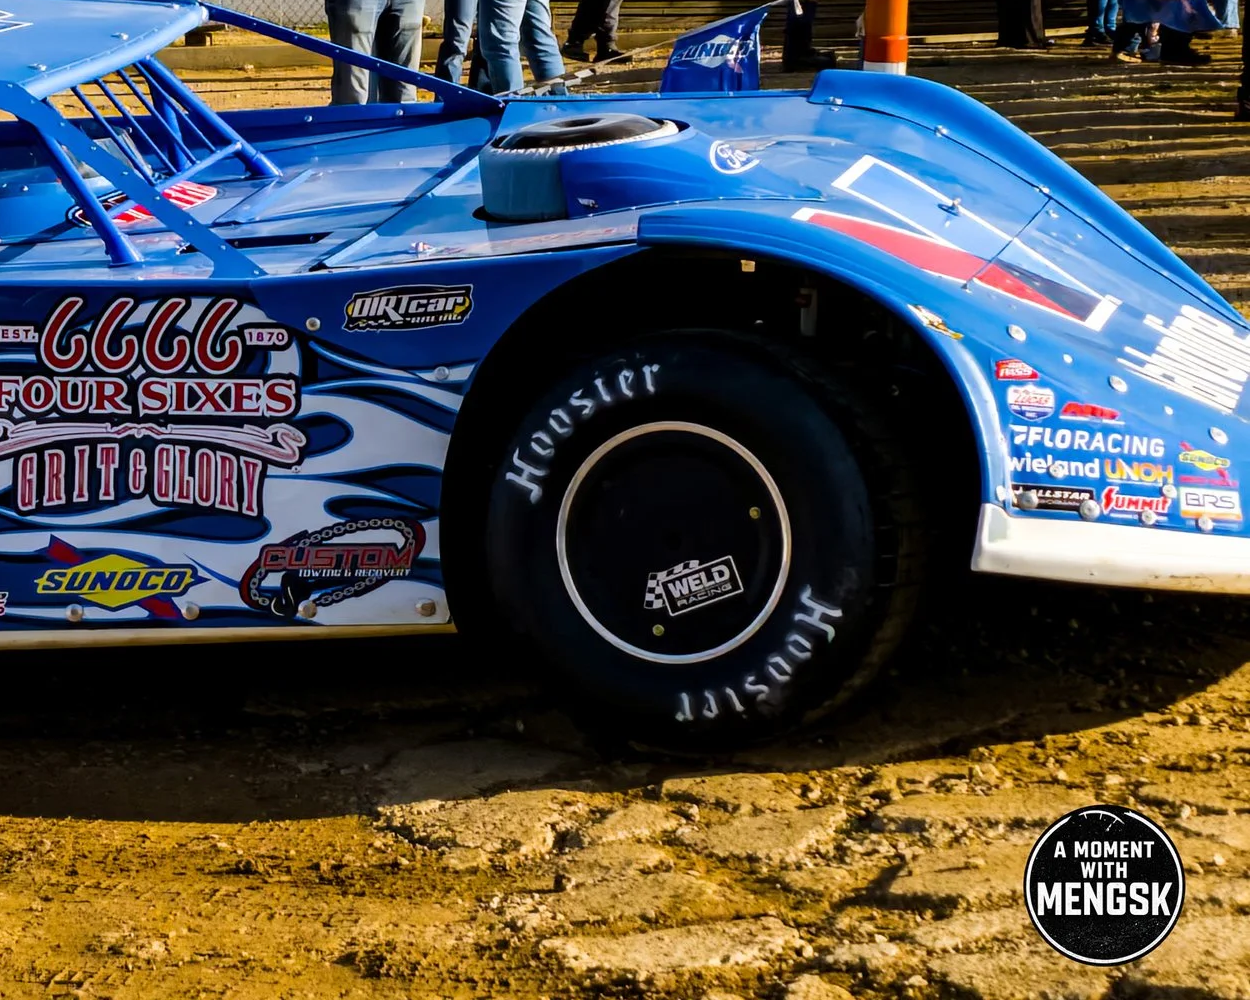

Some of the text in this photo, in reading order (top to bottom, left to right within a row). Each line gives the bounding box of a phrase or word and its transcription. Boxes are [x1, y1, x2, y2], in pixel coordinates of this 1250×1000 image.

[351, 294, 464, 321] DIRTcar
[39, 297, 242, 374] 6666
[246, 331, 286, 344] 1870
[138, 378, 297, 417] SIXES
[505, 362, 661, 505] Hoosier
[1026, 426, 1165, 458] FLORACING
[17, 443, 263, 517] GRIT & GLORY
[1105, 459, 1173, 484] UNOH
[1185, 492, 1236, 510] BRS
[262, 546, 415, 569] CUSTOM
[40, 570, 189, 592] SUNOCO
[667, 564, 731, 599] WELD
[676, 582, 733, 608] RACING
[675, 584, 843, 722] Hoosier
